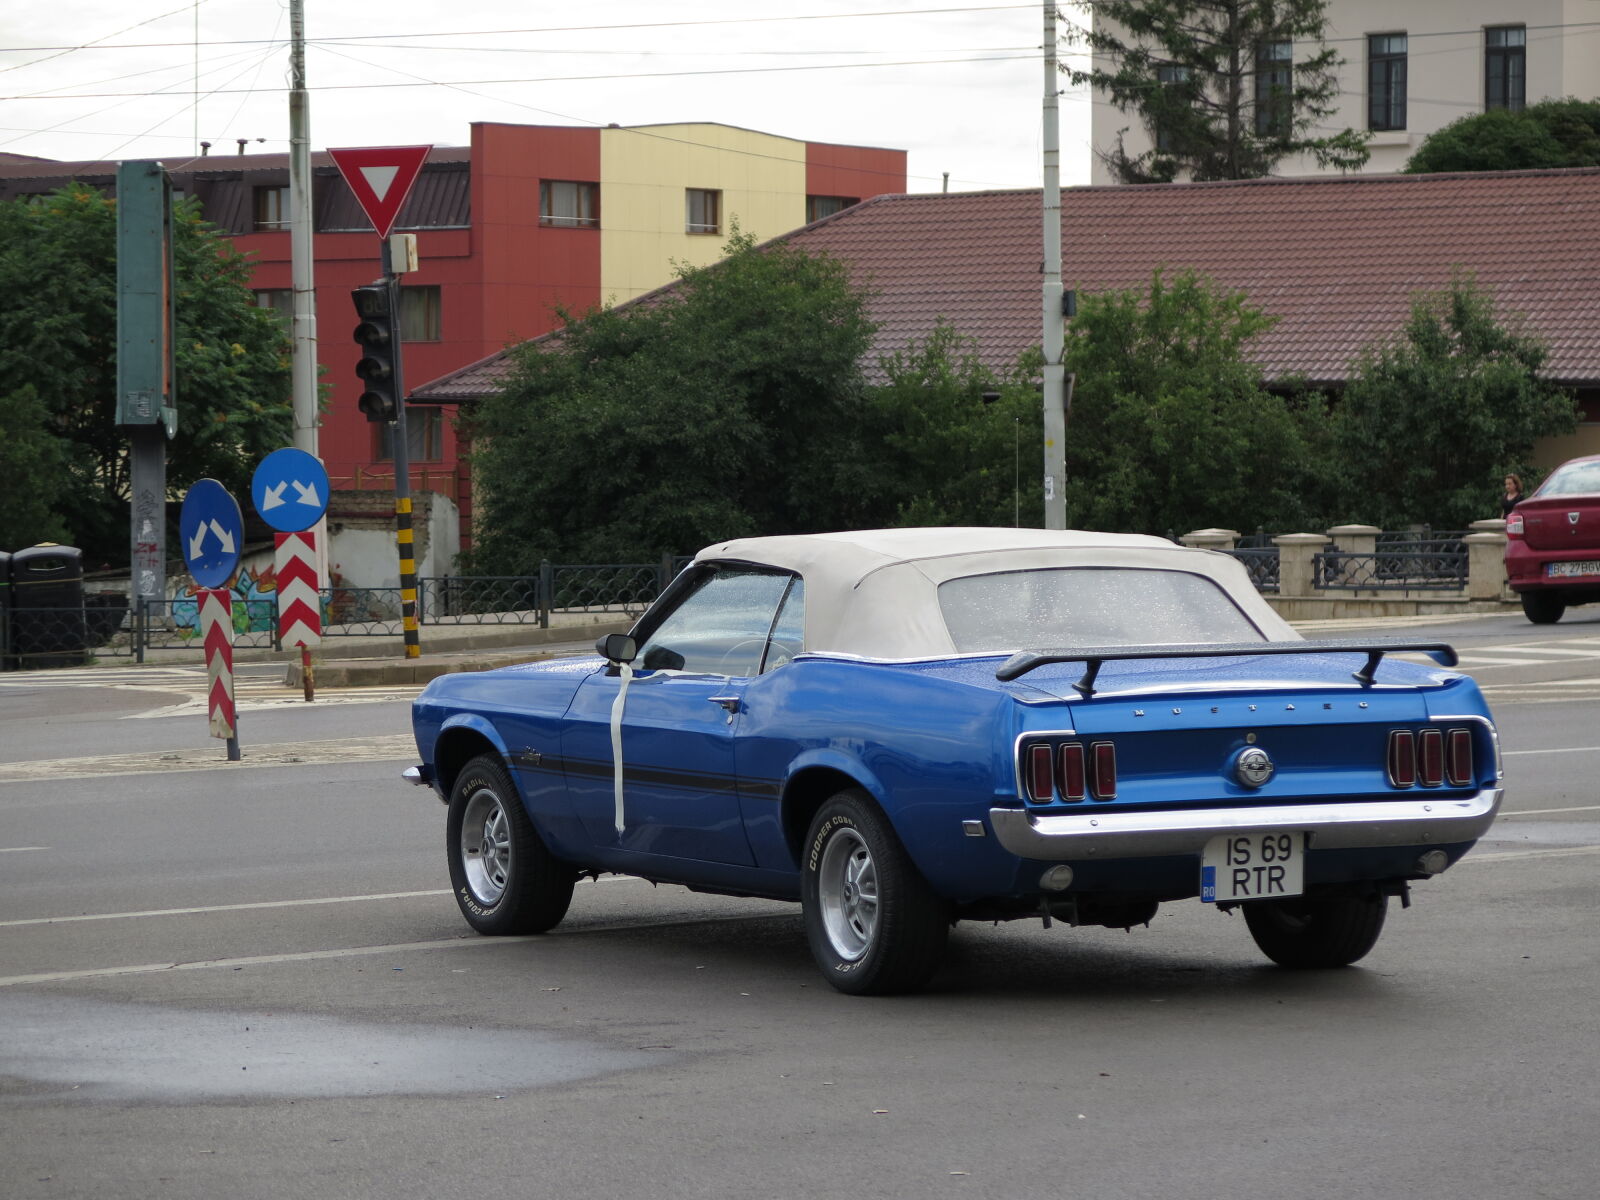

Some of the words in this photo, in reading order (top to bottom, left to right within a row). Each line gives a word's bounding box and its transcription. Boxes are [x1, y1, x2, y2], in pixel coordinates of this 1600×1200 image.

[1133, 701, 1369, 717] MUSTANG
[809, 821, 832, 871] COOPER
[1226, 837, 1251, 866] IS
[1261, 834, 1292, 863] 69
[1203, 886, 1215, 897] RO
[1232, 865, 1286, 896] RTR
[460, 886, 482, 915] COBRA
